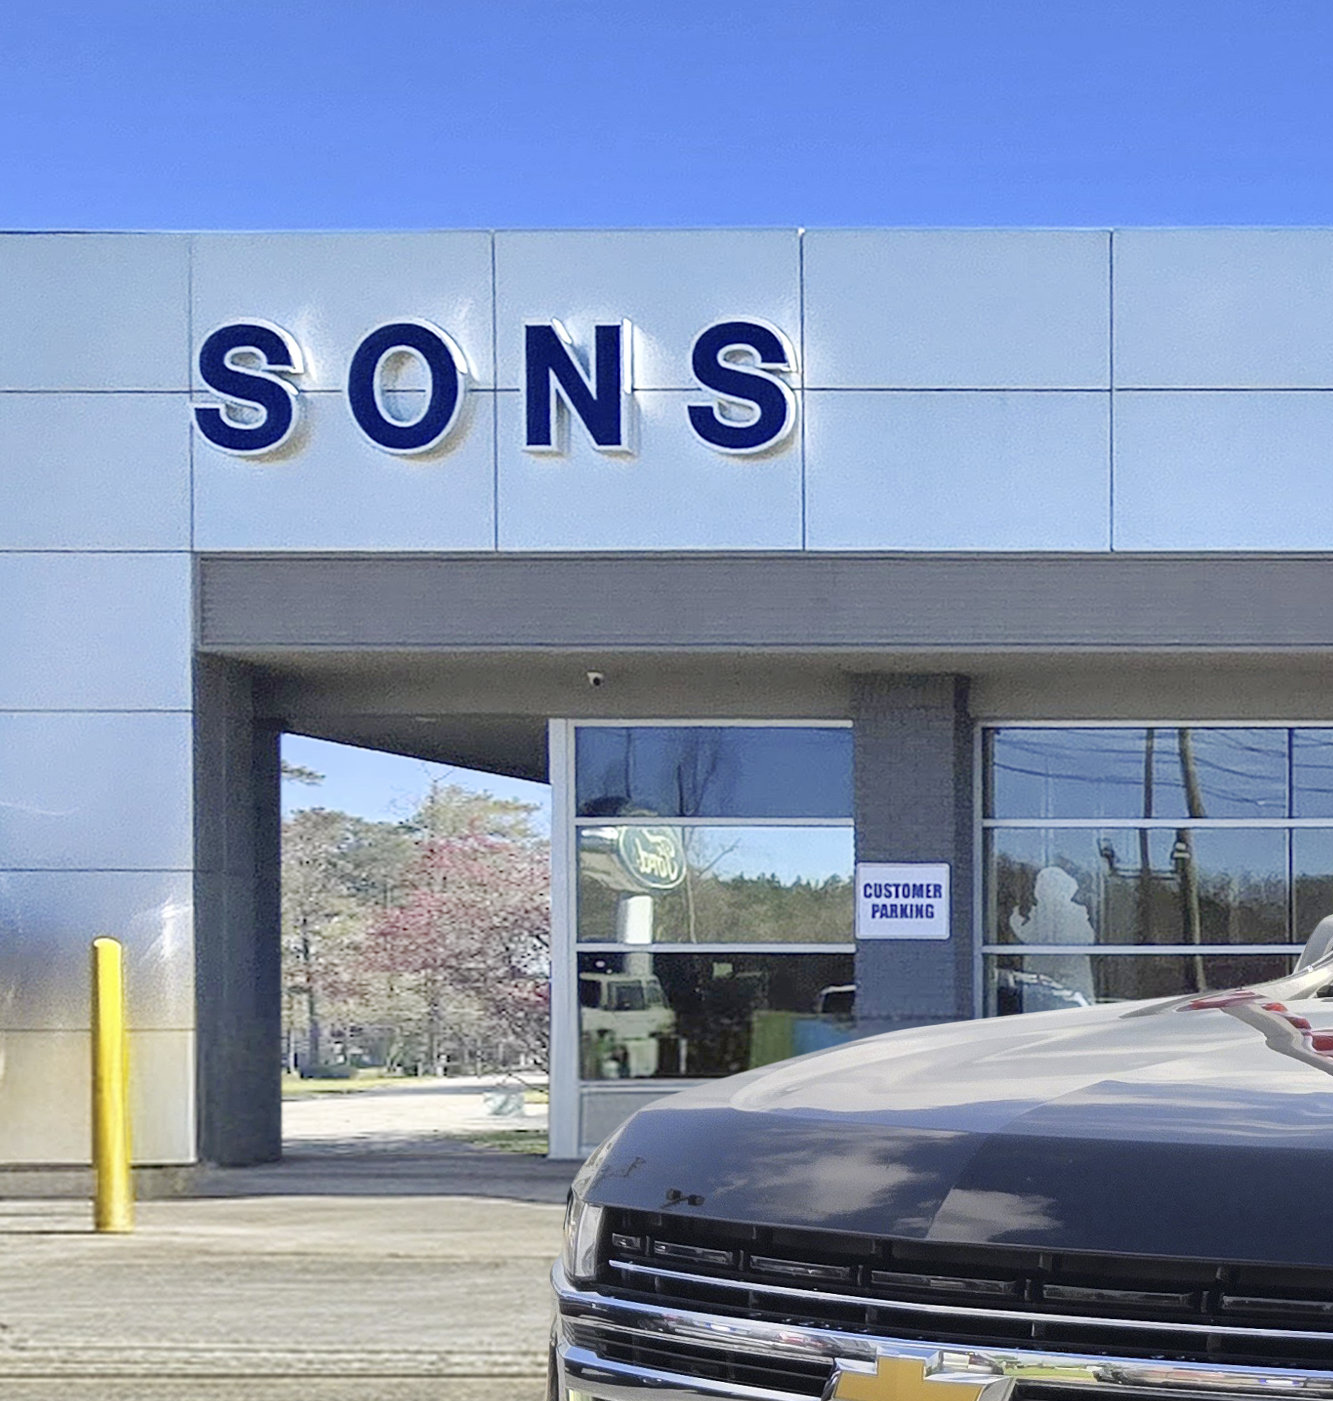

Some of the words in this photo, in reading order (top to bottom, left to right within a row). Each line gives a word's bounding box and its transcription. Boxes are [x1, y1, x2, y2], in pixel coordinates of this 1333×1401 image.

[193, 320, 797, 454] SONS
[863, 883, 942, 899] CUSTOMER
[871, 903, 934, 919] PARKING
